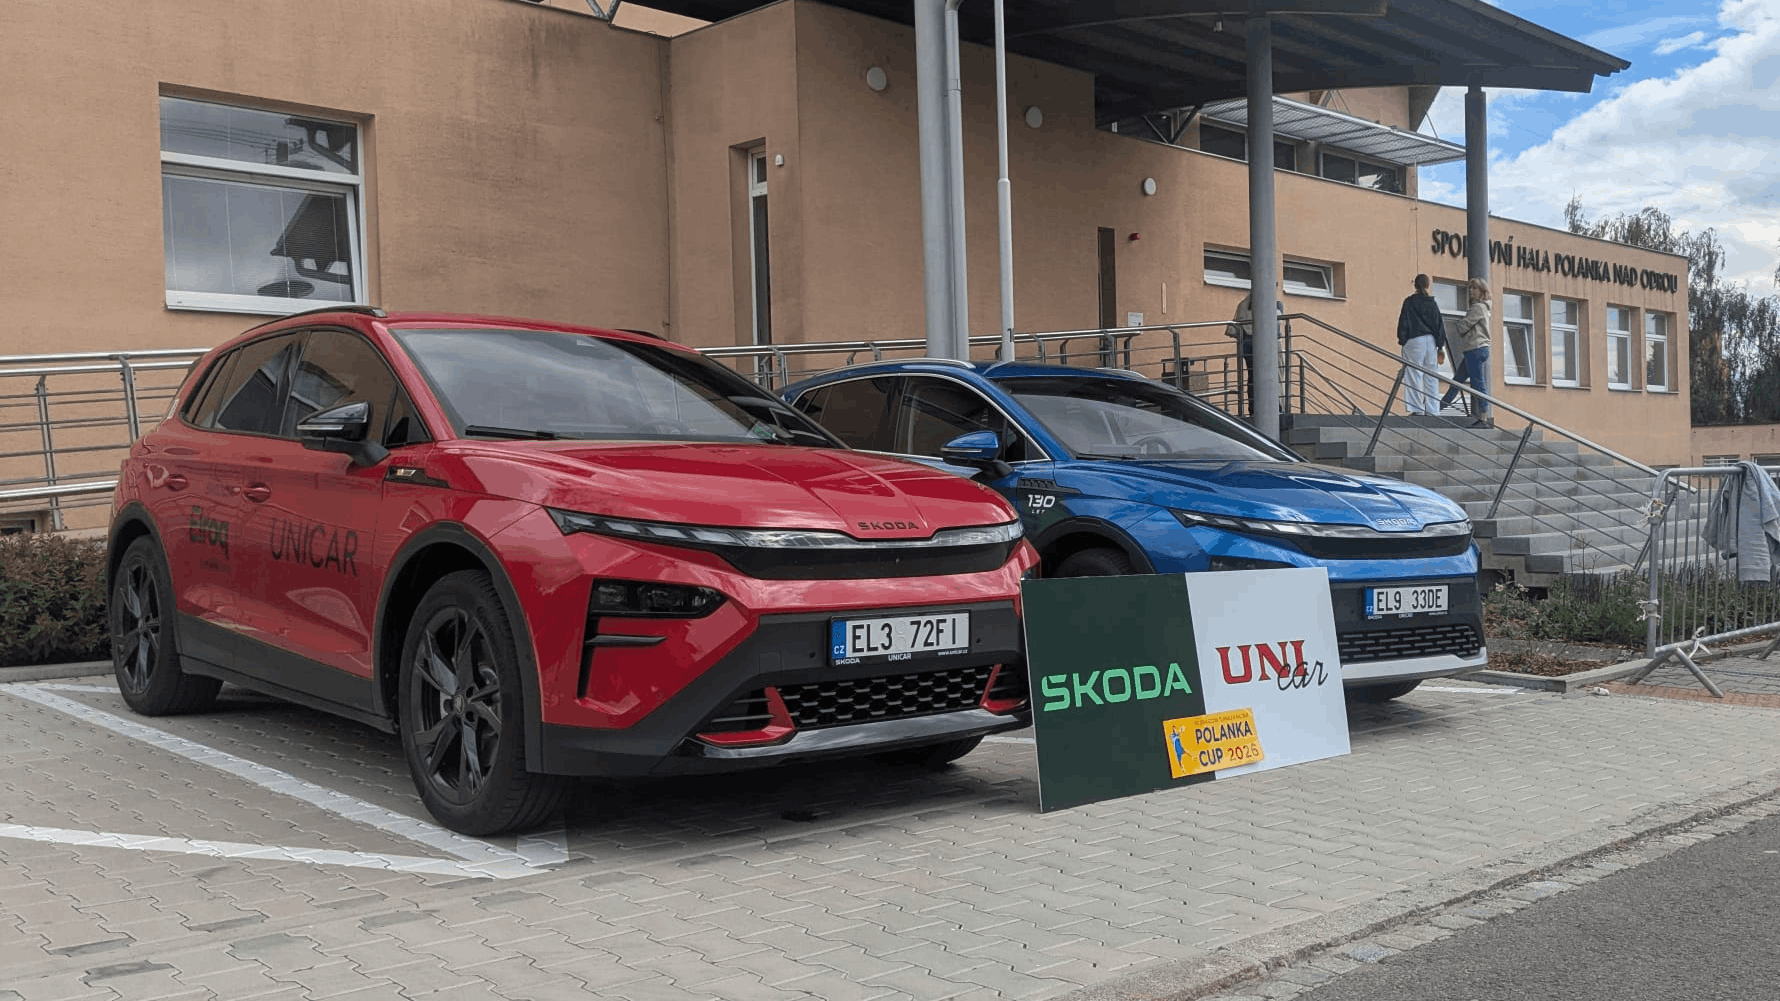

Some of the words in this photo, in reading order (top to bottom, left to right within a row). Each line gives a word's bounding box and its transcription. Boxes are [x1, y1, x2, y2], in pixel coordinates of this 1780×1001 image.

[1431, 228, 1513, 266] SPOVNÍ
[1517, 245, 1551, 273] HALA
[1554, 252, 1611, 283] POLANKA
[1613, 262, 1638, 287] NAD
[1640, 268, 1678, 294] ODROU
[1028, 494, 1055, 508] 130
[271, 517, 358, 578] UNICAR
[1376, 590, 1402, 612] EL9
[1411, 588, 1443, 609] 33DE
[833, 645, 845, 655] CZ
[852, 623, 893, 653] EL3
[888, 652, 912, 662] UNICAR
[1215, 639, 1305, 685] UNI
[1277, 658, 1329, 692] car
[1195, 720, 1253, 745] POLANKA
[1199, 747, 1223, 767] CUP
[1227, 743, 1259, 761] 2026
